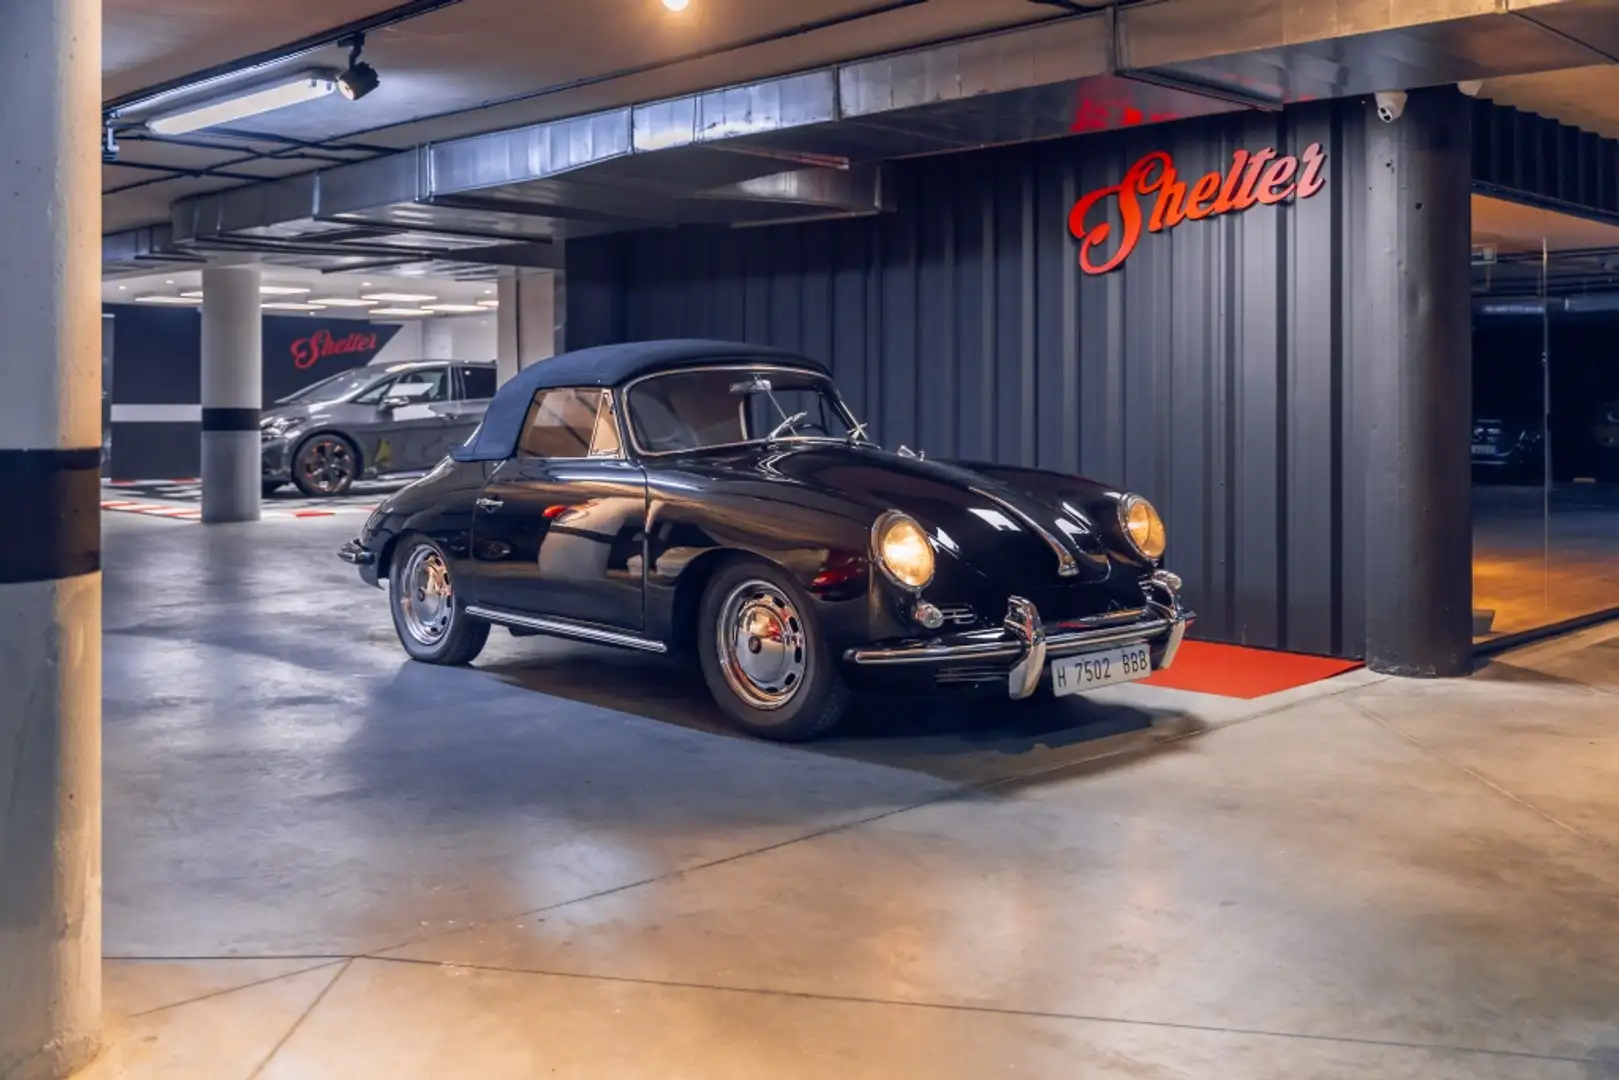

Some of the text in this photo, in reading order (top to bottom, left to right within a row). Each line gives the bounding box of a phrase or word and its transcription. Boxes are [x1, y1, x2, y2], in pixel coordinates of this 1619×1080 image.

[1068, 142, 1326, 275] Shelter
[290, 329, 376, 369] Shelter
[1057, 650, 1148, 688] H 7502 BBB
